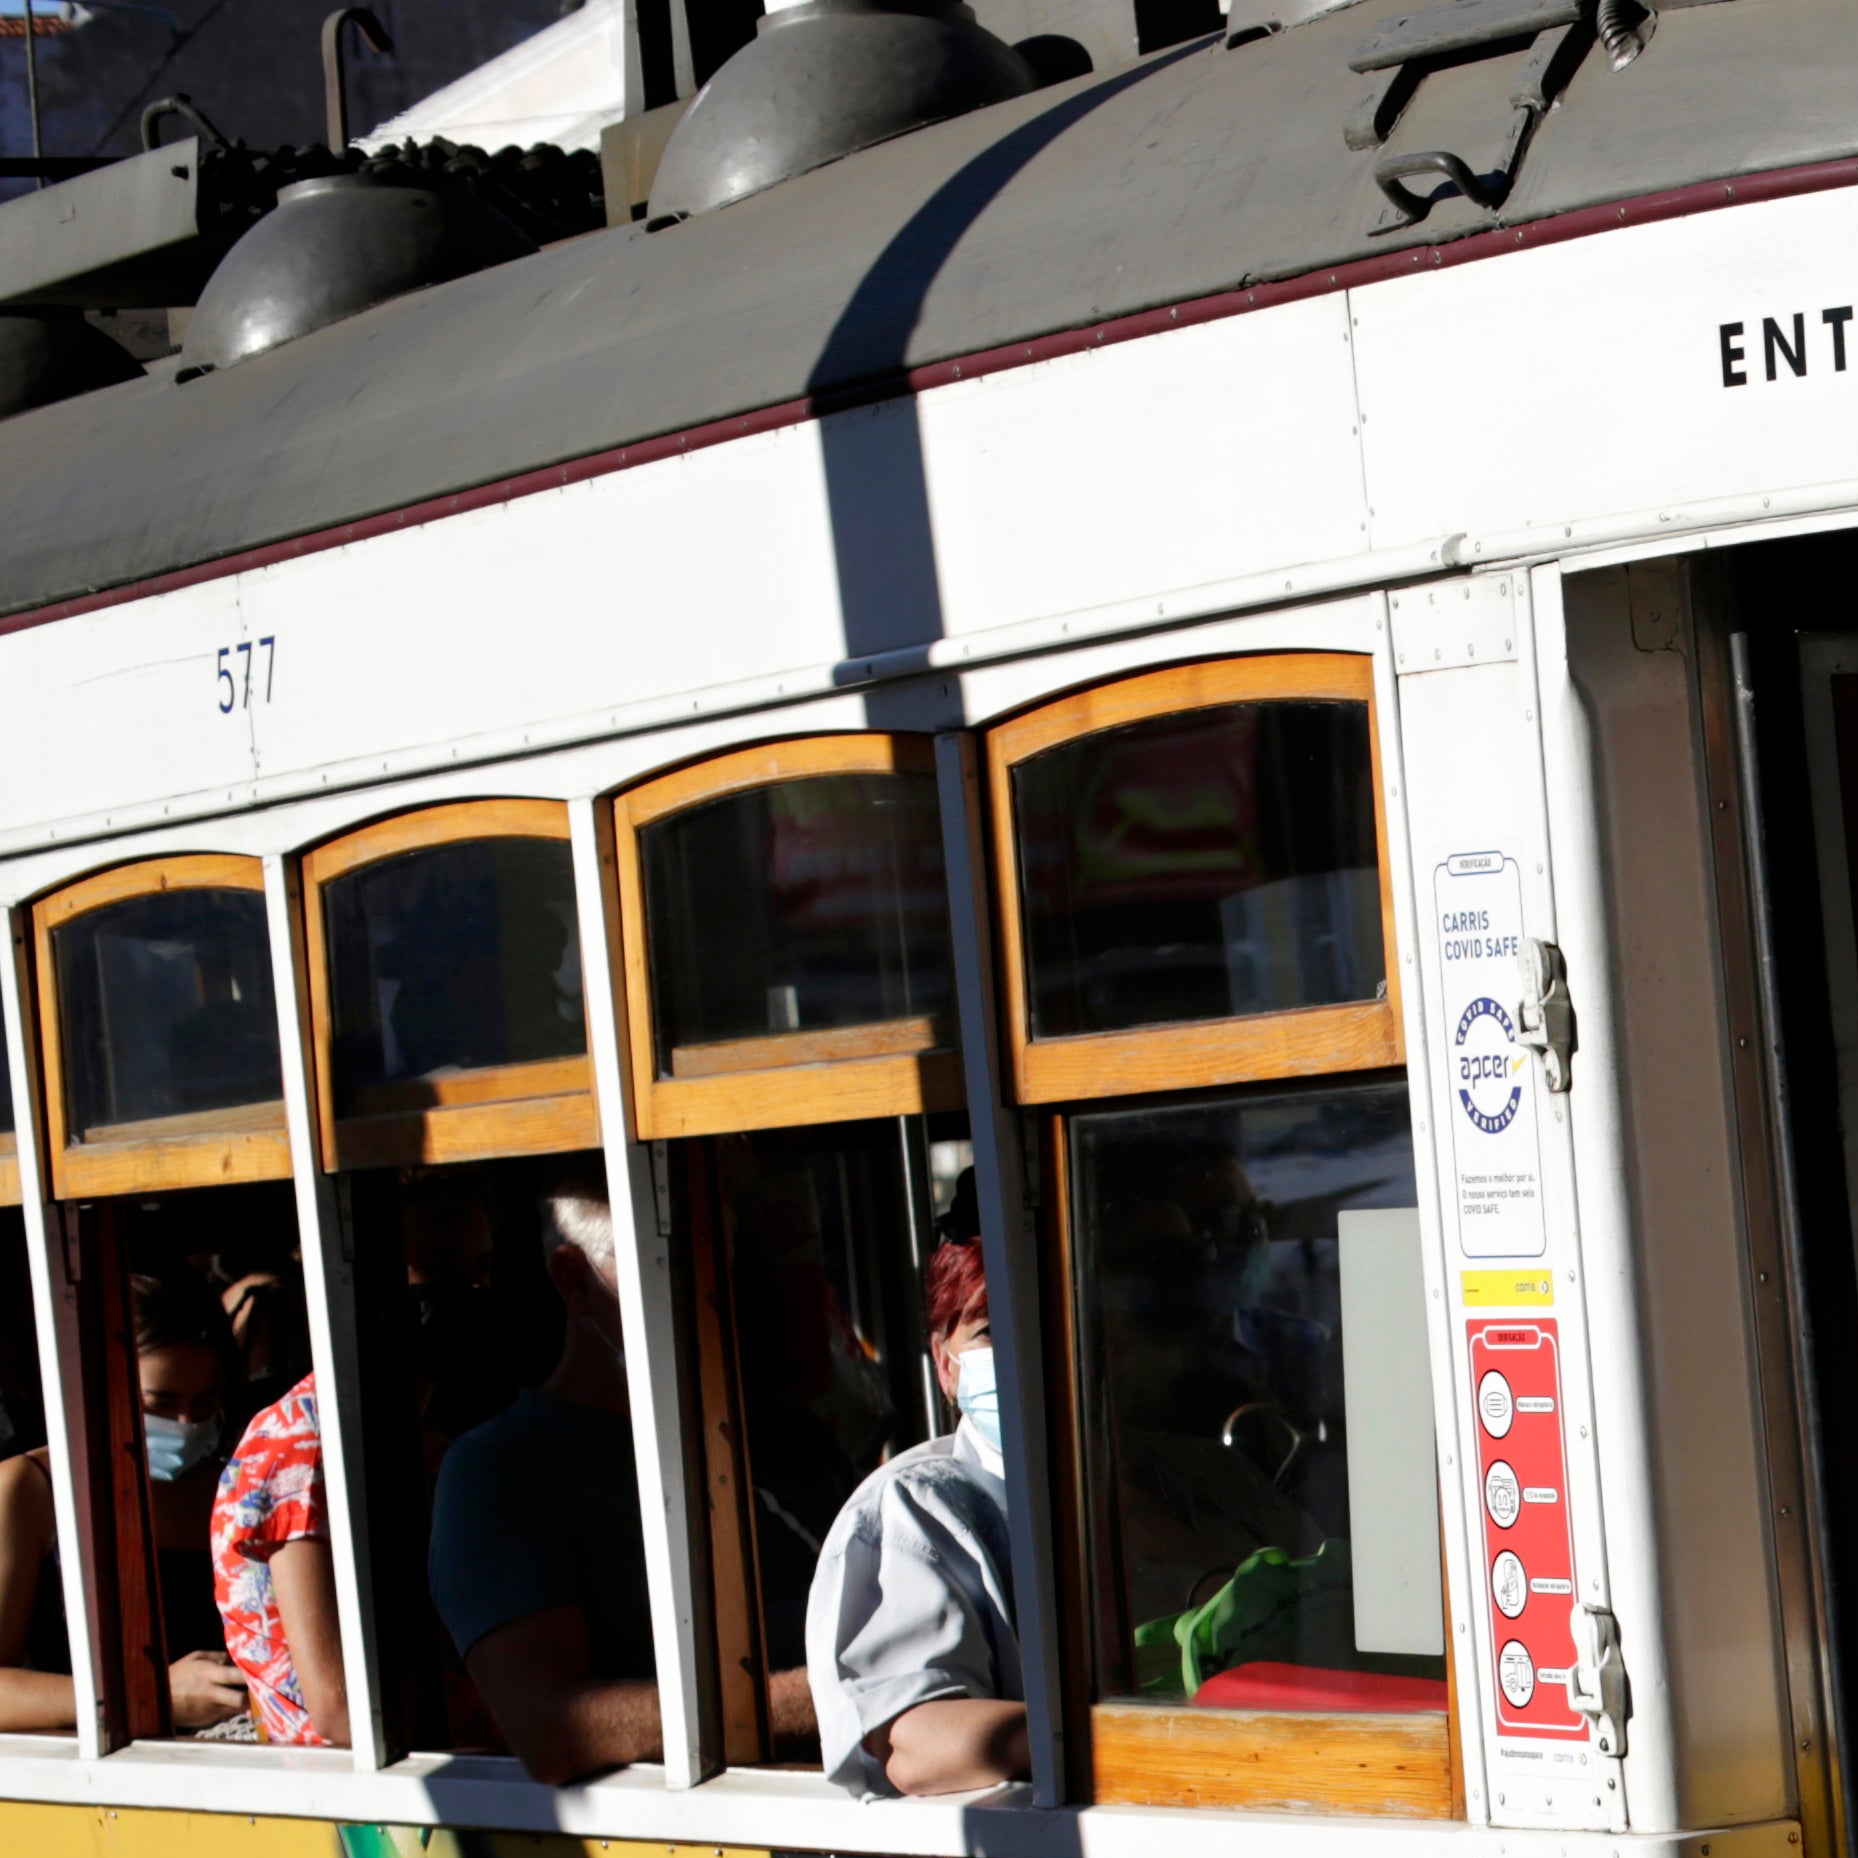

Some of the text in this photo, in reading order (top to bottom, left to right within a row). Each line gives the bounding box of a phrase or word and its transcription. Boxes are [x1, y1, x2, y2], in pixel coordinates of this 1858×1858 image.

[217, 635, 275, 714] 577
[1442, 910, 1490, 933] CARRIS
[1445, 936, 1518, 961] COVID SAFE
[1460, 1054, 1510, 1090] apcer
